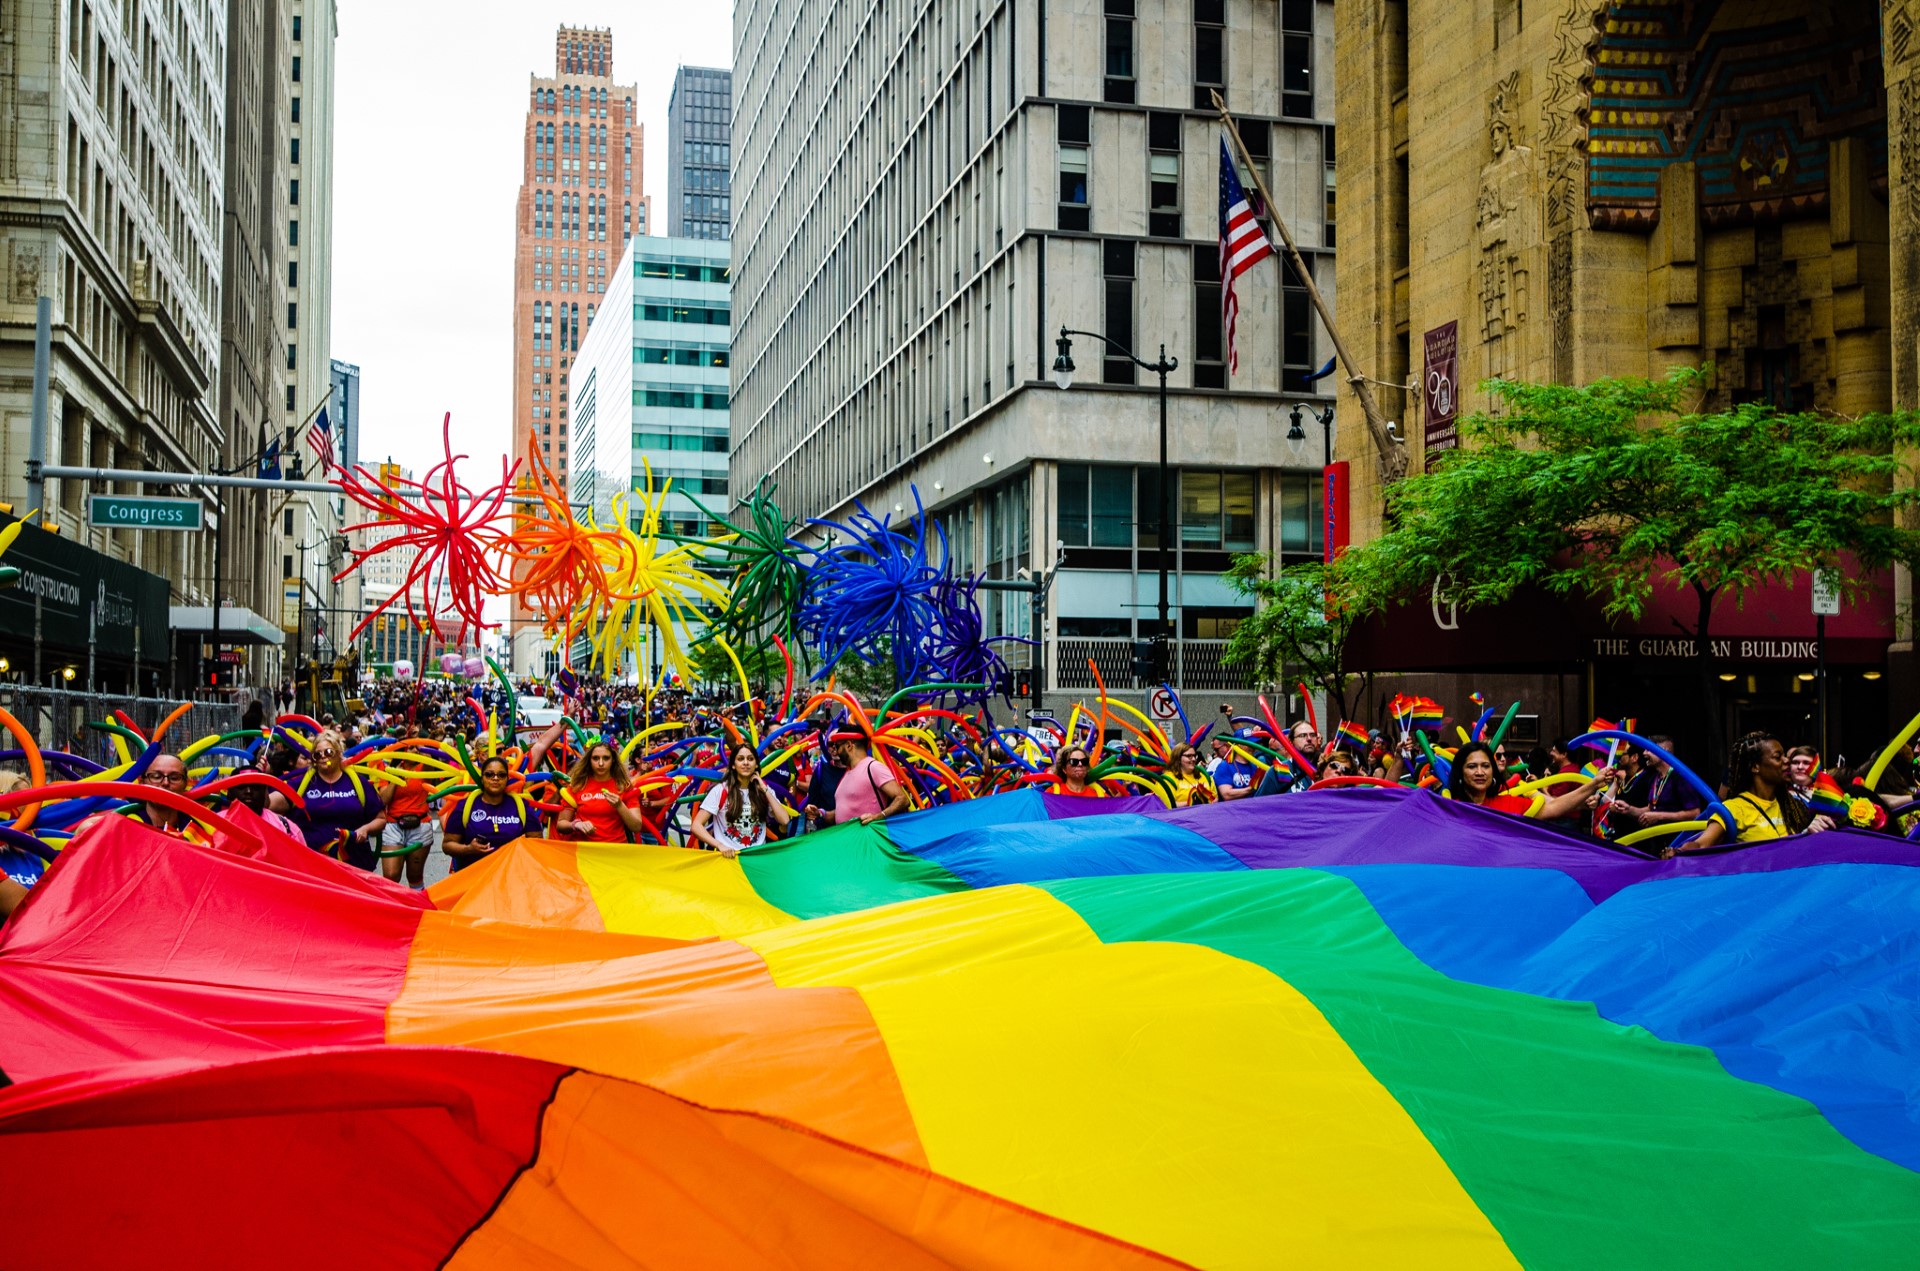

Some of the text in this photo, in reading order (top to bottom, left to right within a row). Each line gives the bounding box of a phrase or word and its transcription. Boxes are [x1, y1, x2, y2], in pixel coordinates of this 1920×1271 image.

[1428, 371, 1451, 416] 90
[108, 504, 183, 524] Congress
[23, 570, 80, 606] CONSTRUCTION
[1593, 639, 1818, 659] THE GUARAN BUILDING
[1035, 729, 1054, 741] FREE
